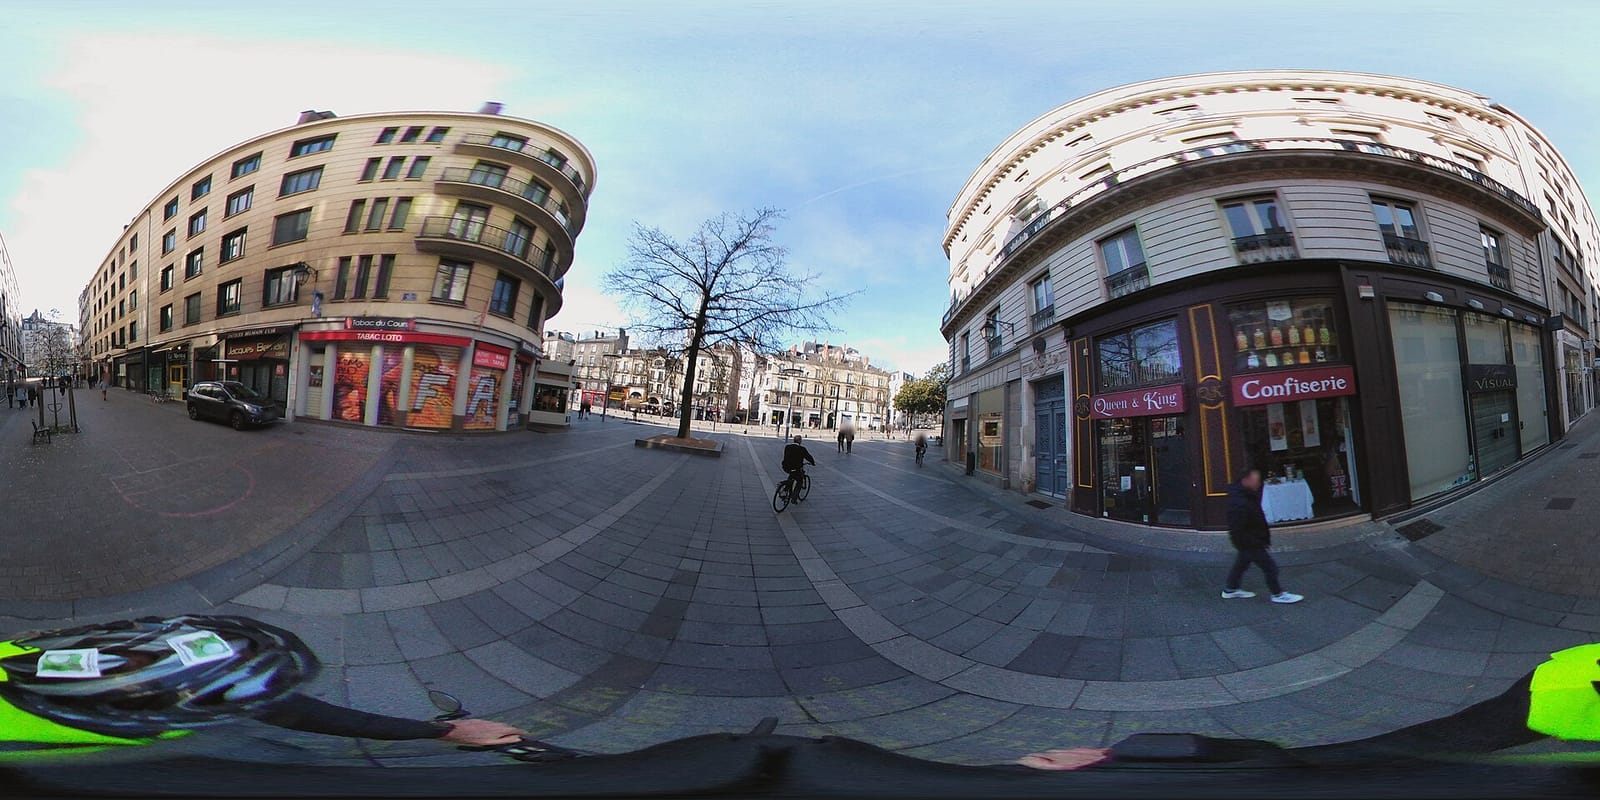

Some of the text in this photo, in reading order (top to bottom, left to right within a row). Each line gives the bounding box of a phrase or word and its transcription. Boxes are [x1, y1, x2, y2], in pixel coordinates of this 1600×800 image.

[352, 319, 374, 327] Tabac
[375, 319, 385, 327] du
[357, 333, 403, 342] TABAC LOTO
[228, 346, 254, 356] Jacques
[1241, 376, 1347, 399] Confiserie
[1475, 378, 1514, 389] VISUAL
[1094, 391, 1177, 417] Queen & King
